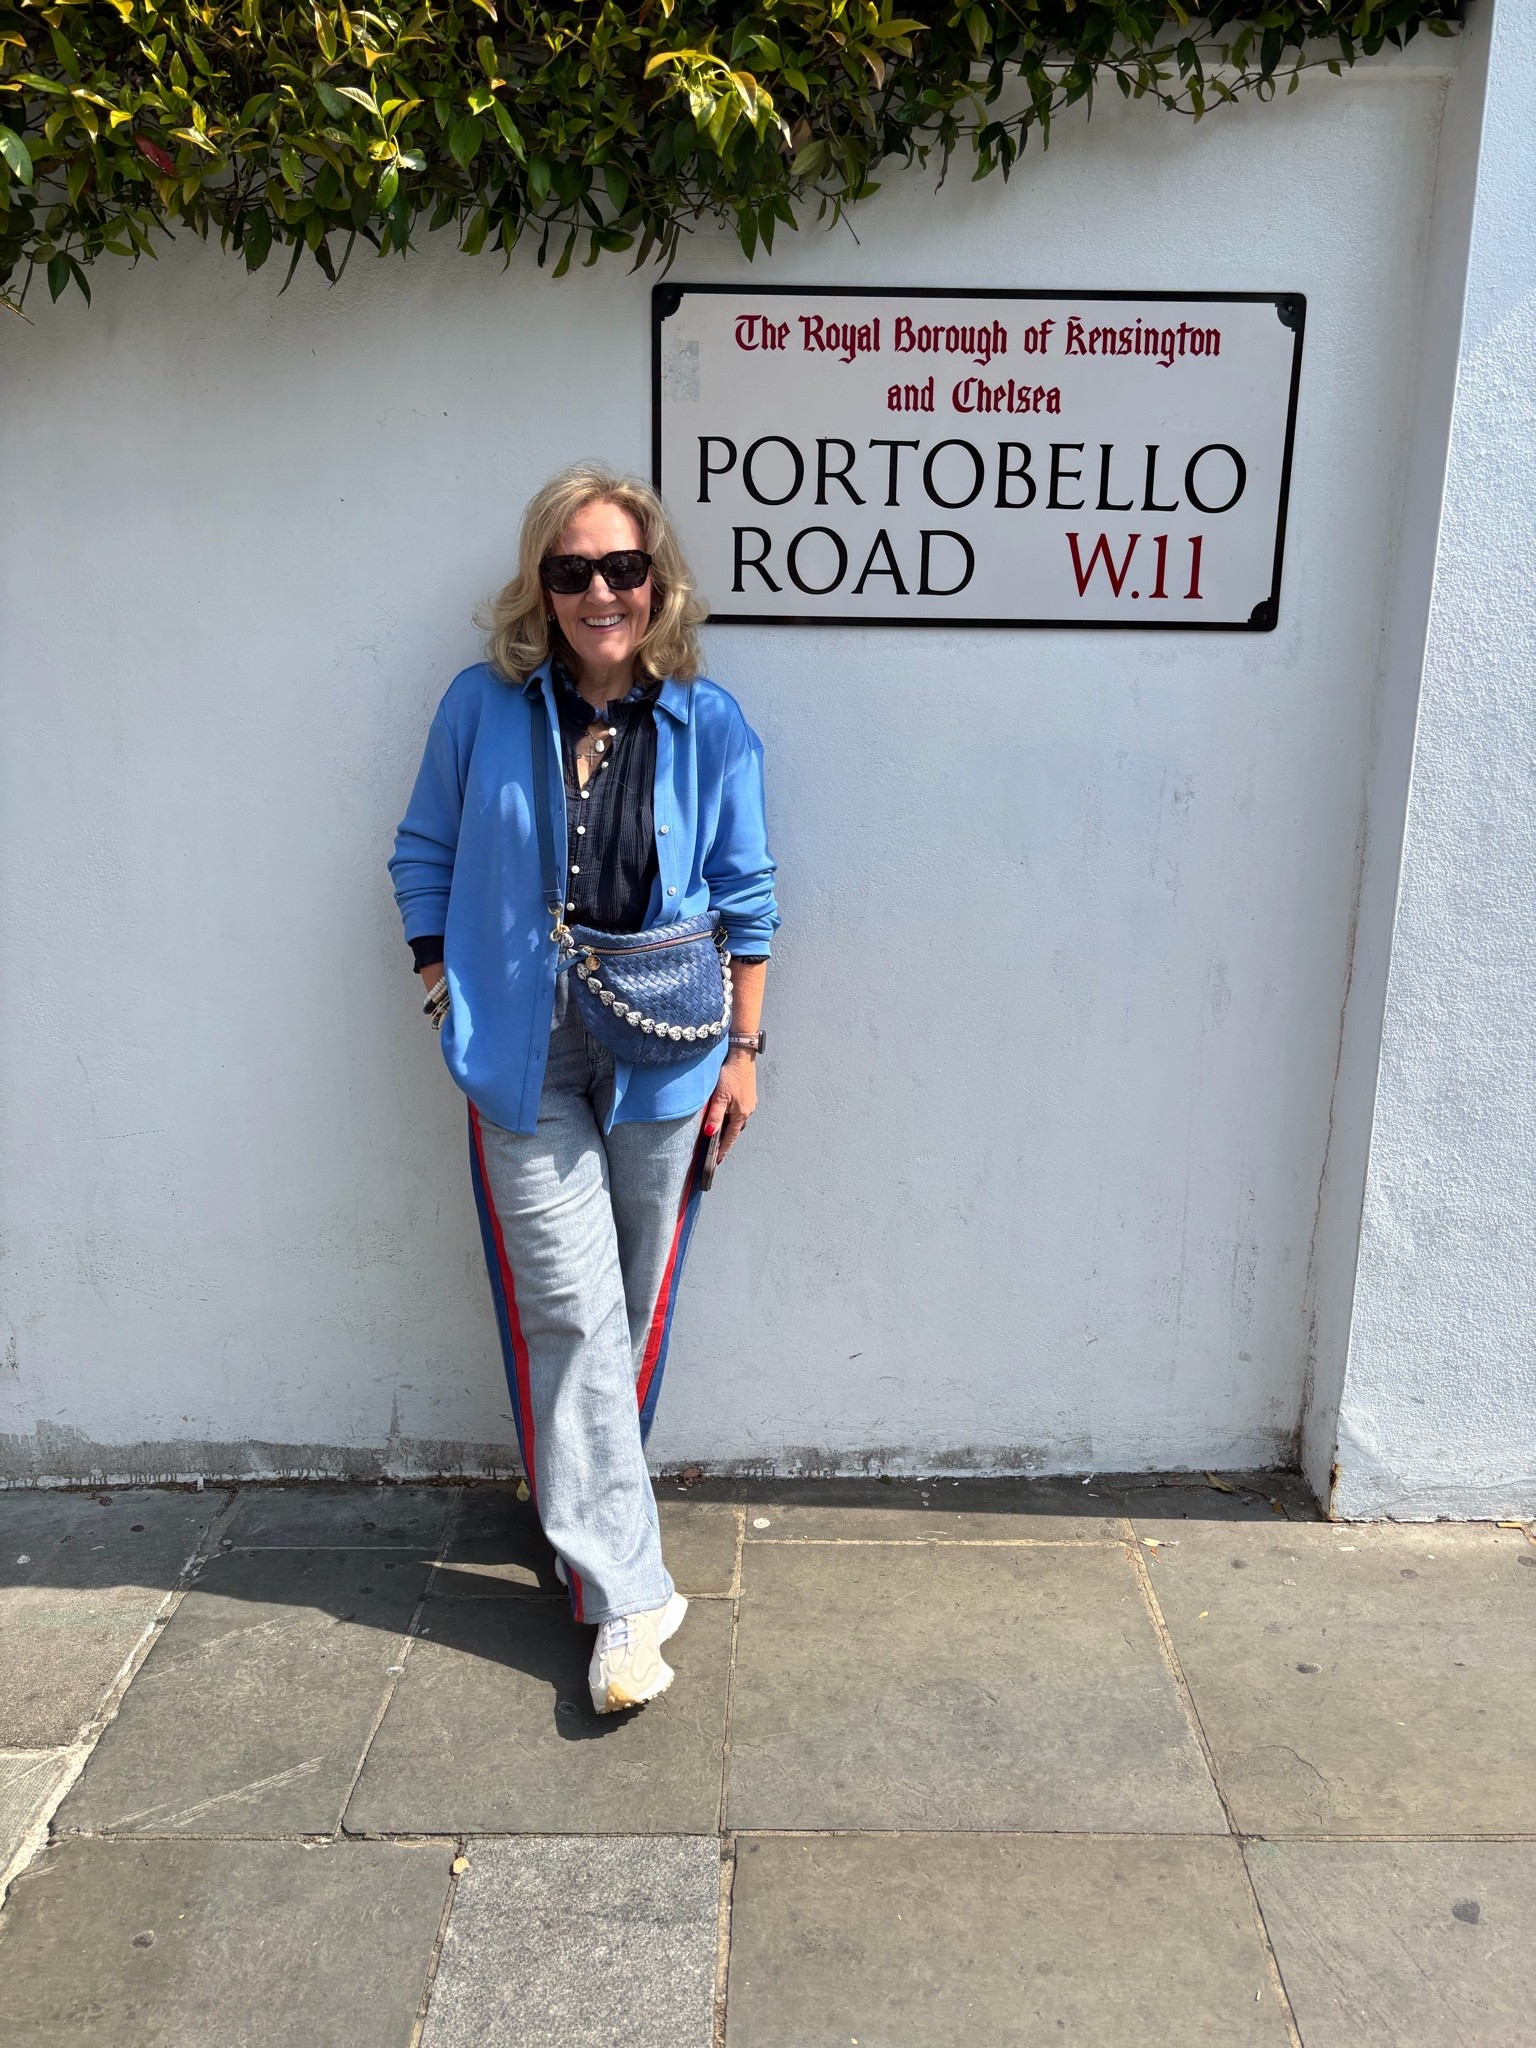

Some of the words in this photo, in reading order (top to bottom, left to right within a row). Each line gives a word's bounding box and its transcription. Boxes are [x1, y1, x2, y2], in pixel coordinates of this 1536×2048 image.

[734, 314, 791, 352] The
[797, 314, 881, 365] Royal
[894, 315, 1008, 367] Borough
[1023, 318, 1057, 355] of
[1064, 315, 1221, 369] Kensington
[887, 375, 935, 413] and
[951, 376, 1062, 415] Chelsea
[696, 435, 1247, 514] PORTOBELLO
[731, 526, 975, 596] ROAD
[1065, 532, 1203, 600] W.11
